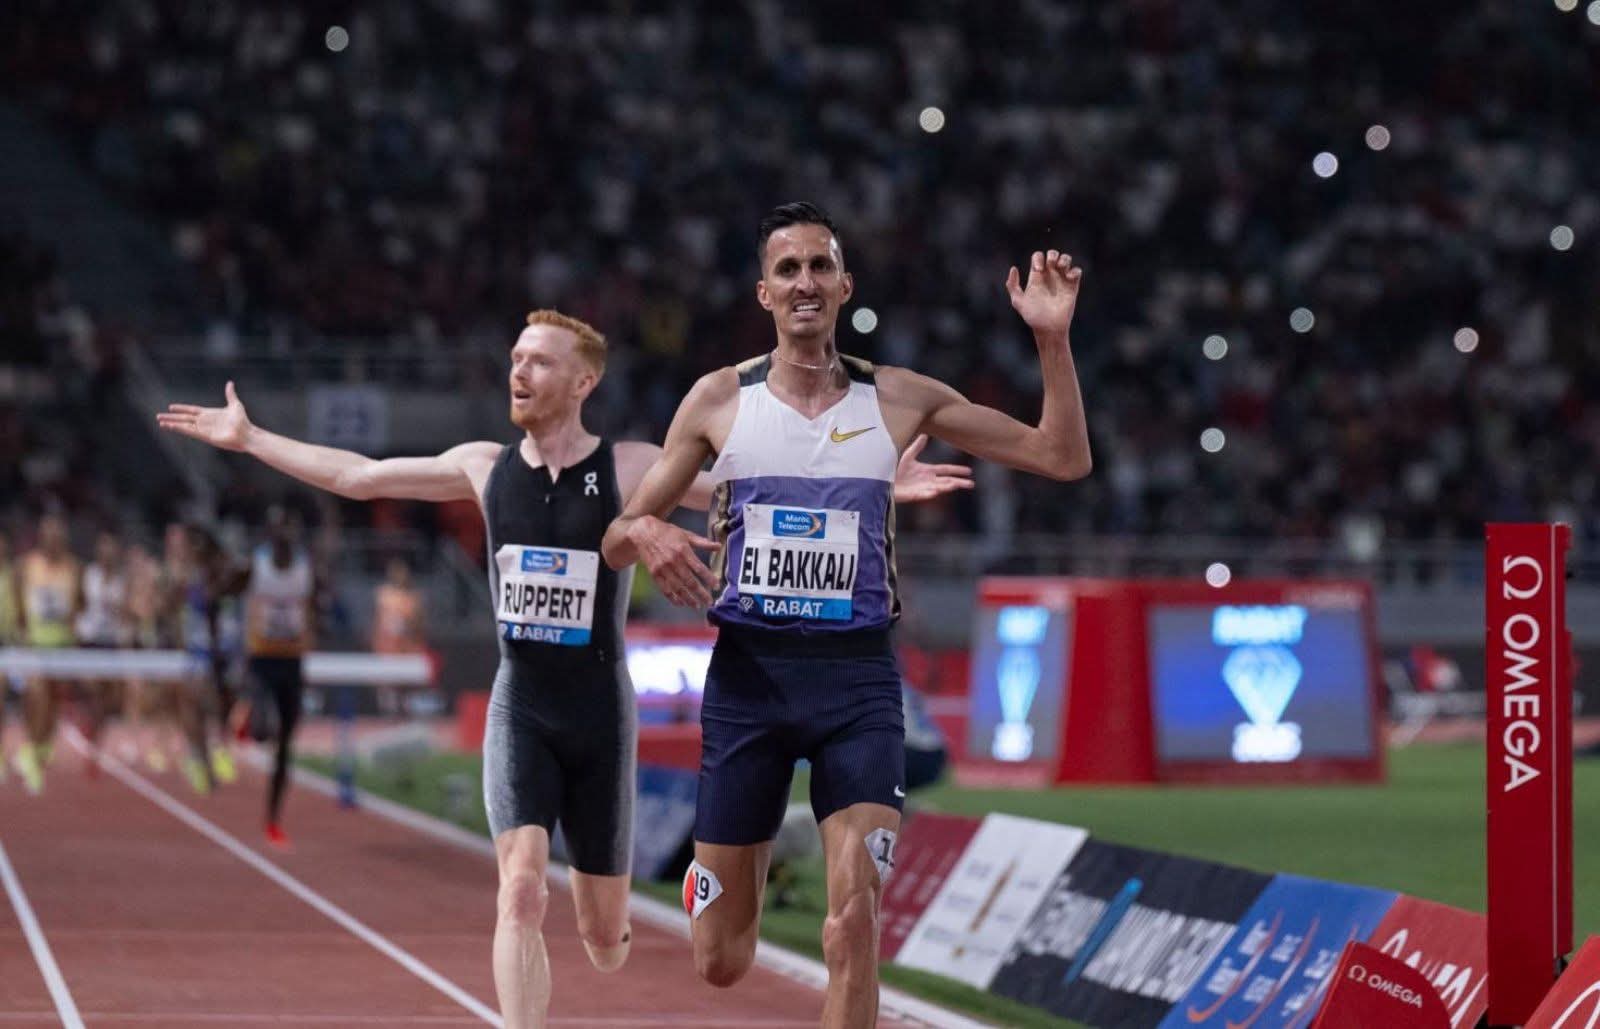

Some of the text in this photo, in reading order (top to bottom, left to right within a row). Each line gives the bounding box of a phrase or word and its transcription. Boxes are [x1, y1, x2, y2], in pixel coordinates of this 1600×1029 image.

[778, 521, 811, 531] Telecom
[785, 513, 810, 523] Maroc
[740, 547, 855, 591] EL BAKKALI
[504, 582, 587, 621] RUPPERT
[763, 599, 823, 617] RABAT
[512, 625, 565, 644] RABAT
[1502, 613, 1541, 792] OMEGA
[877, 836, 895, 868] 1
[694, 871, 710, 902] 19
[1367, 974, 1423, 1009] OMEGA
